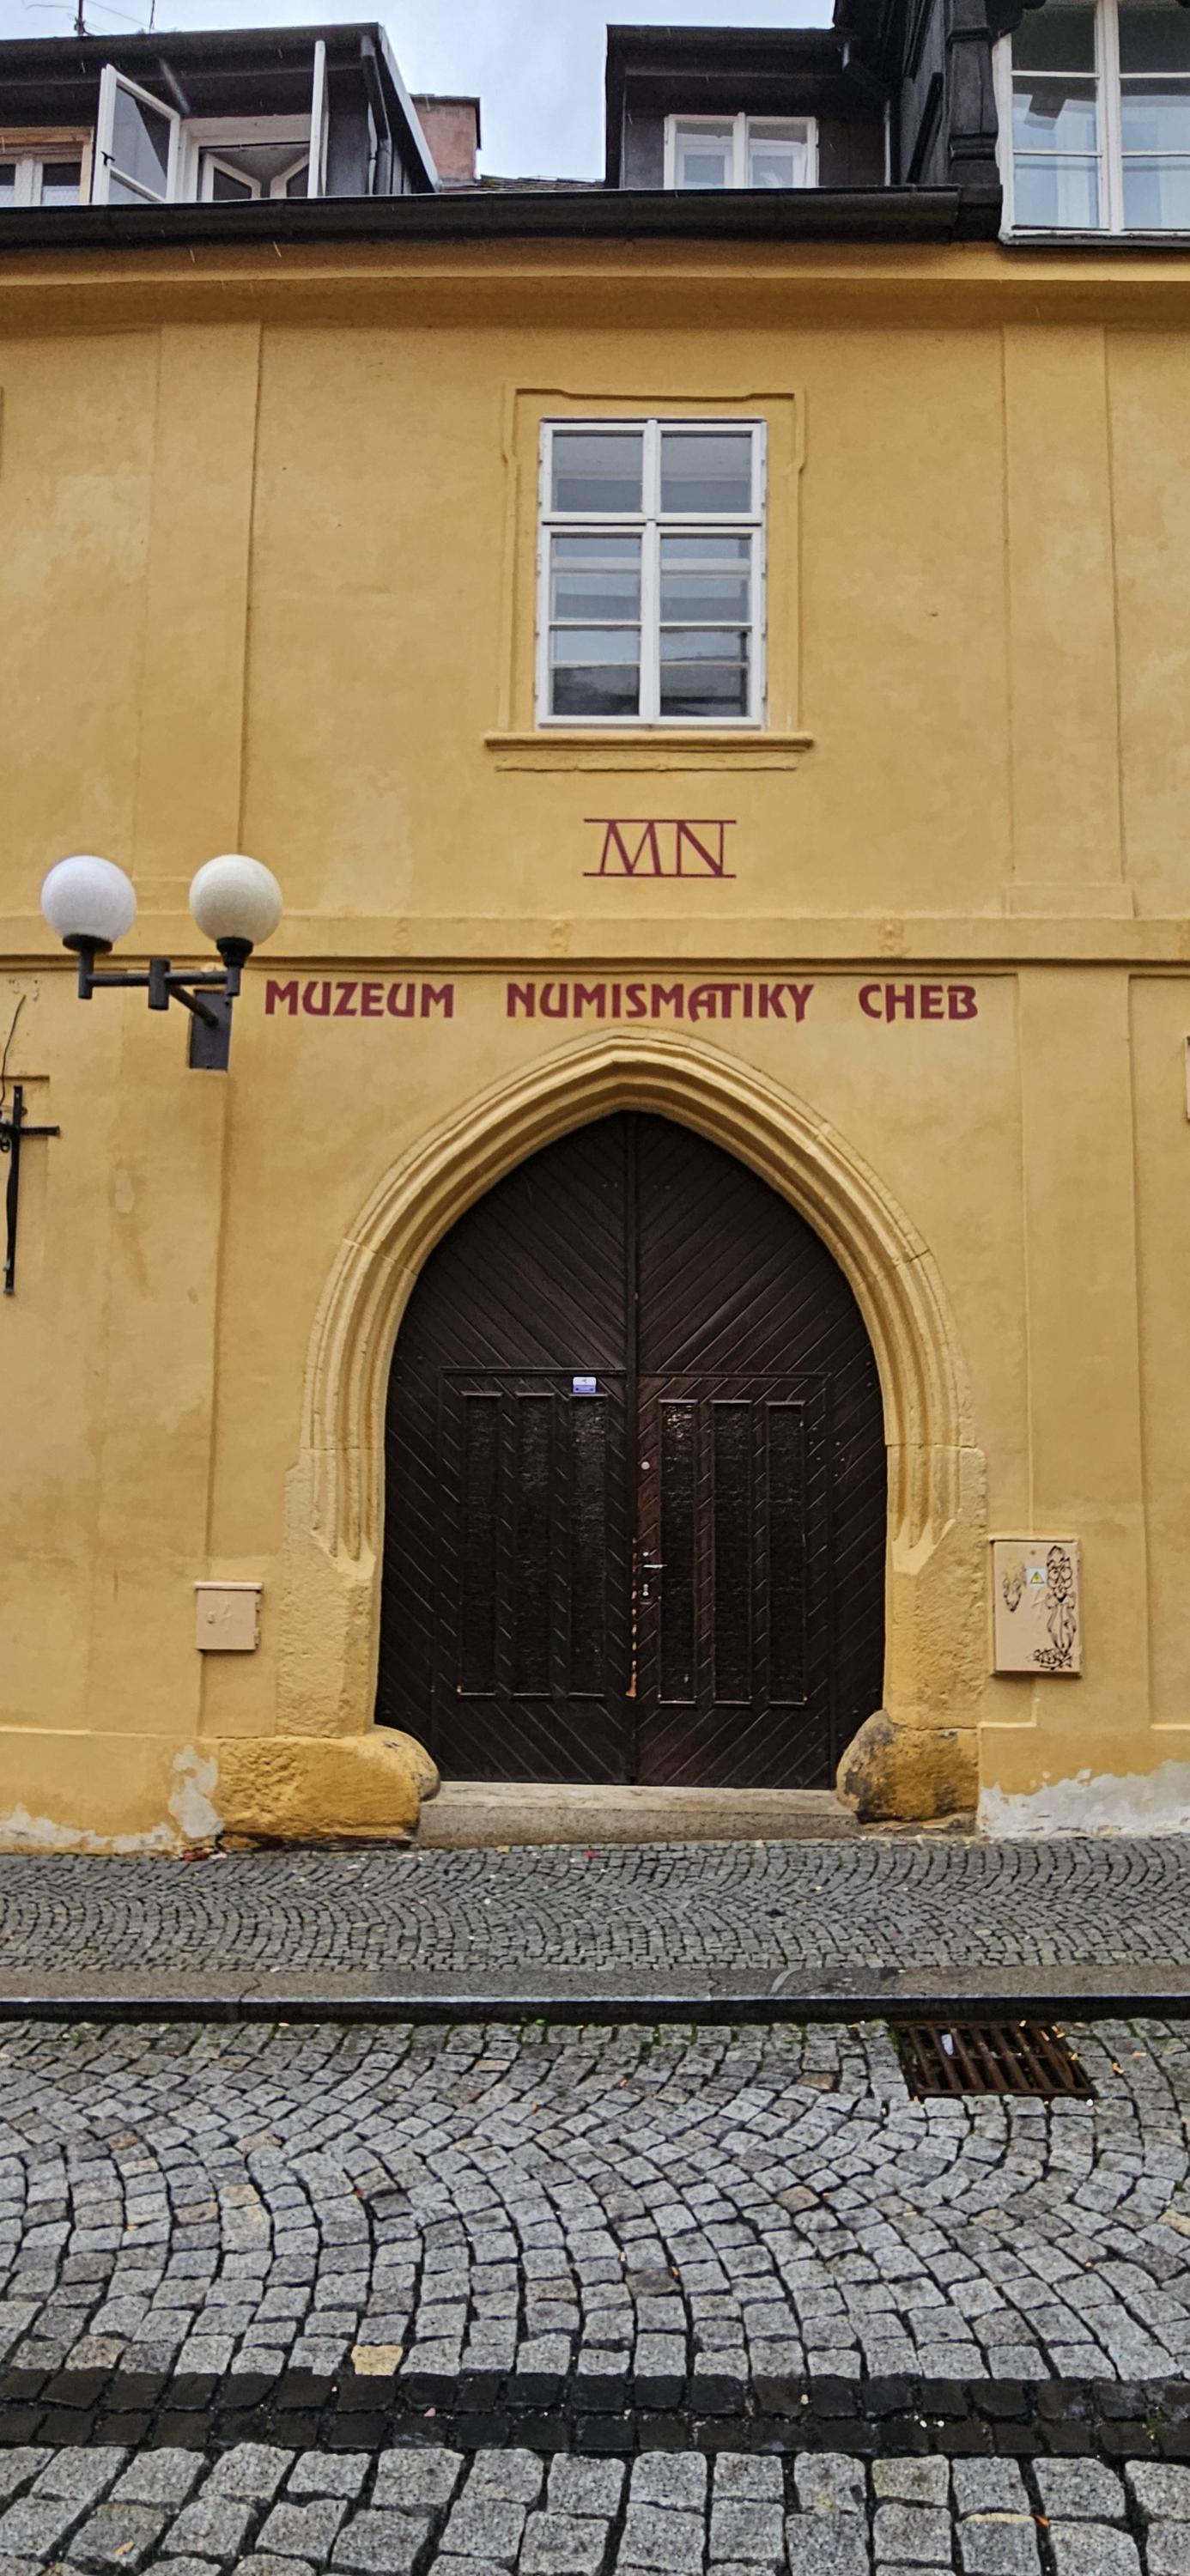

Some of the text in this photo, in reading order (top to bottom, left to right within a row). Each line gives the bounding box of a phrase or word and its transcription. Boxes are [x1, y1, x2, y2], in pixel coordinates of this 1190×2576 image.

[583, 818, 737, 878] MN
[264, 980, 978, 1024] MUZEUM NUMISMATIKY CHEB
